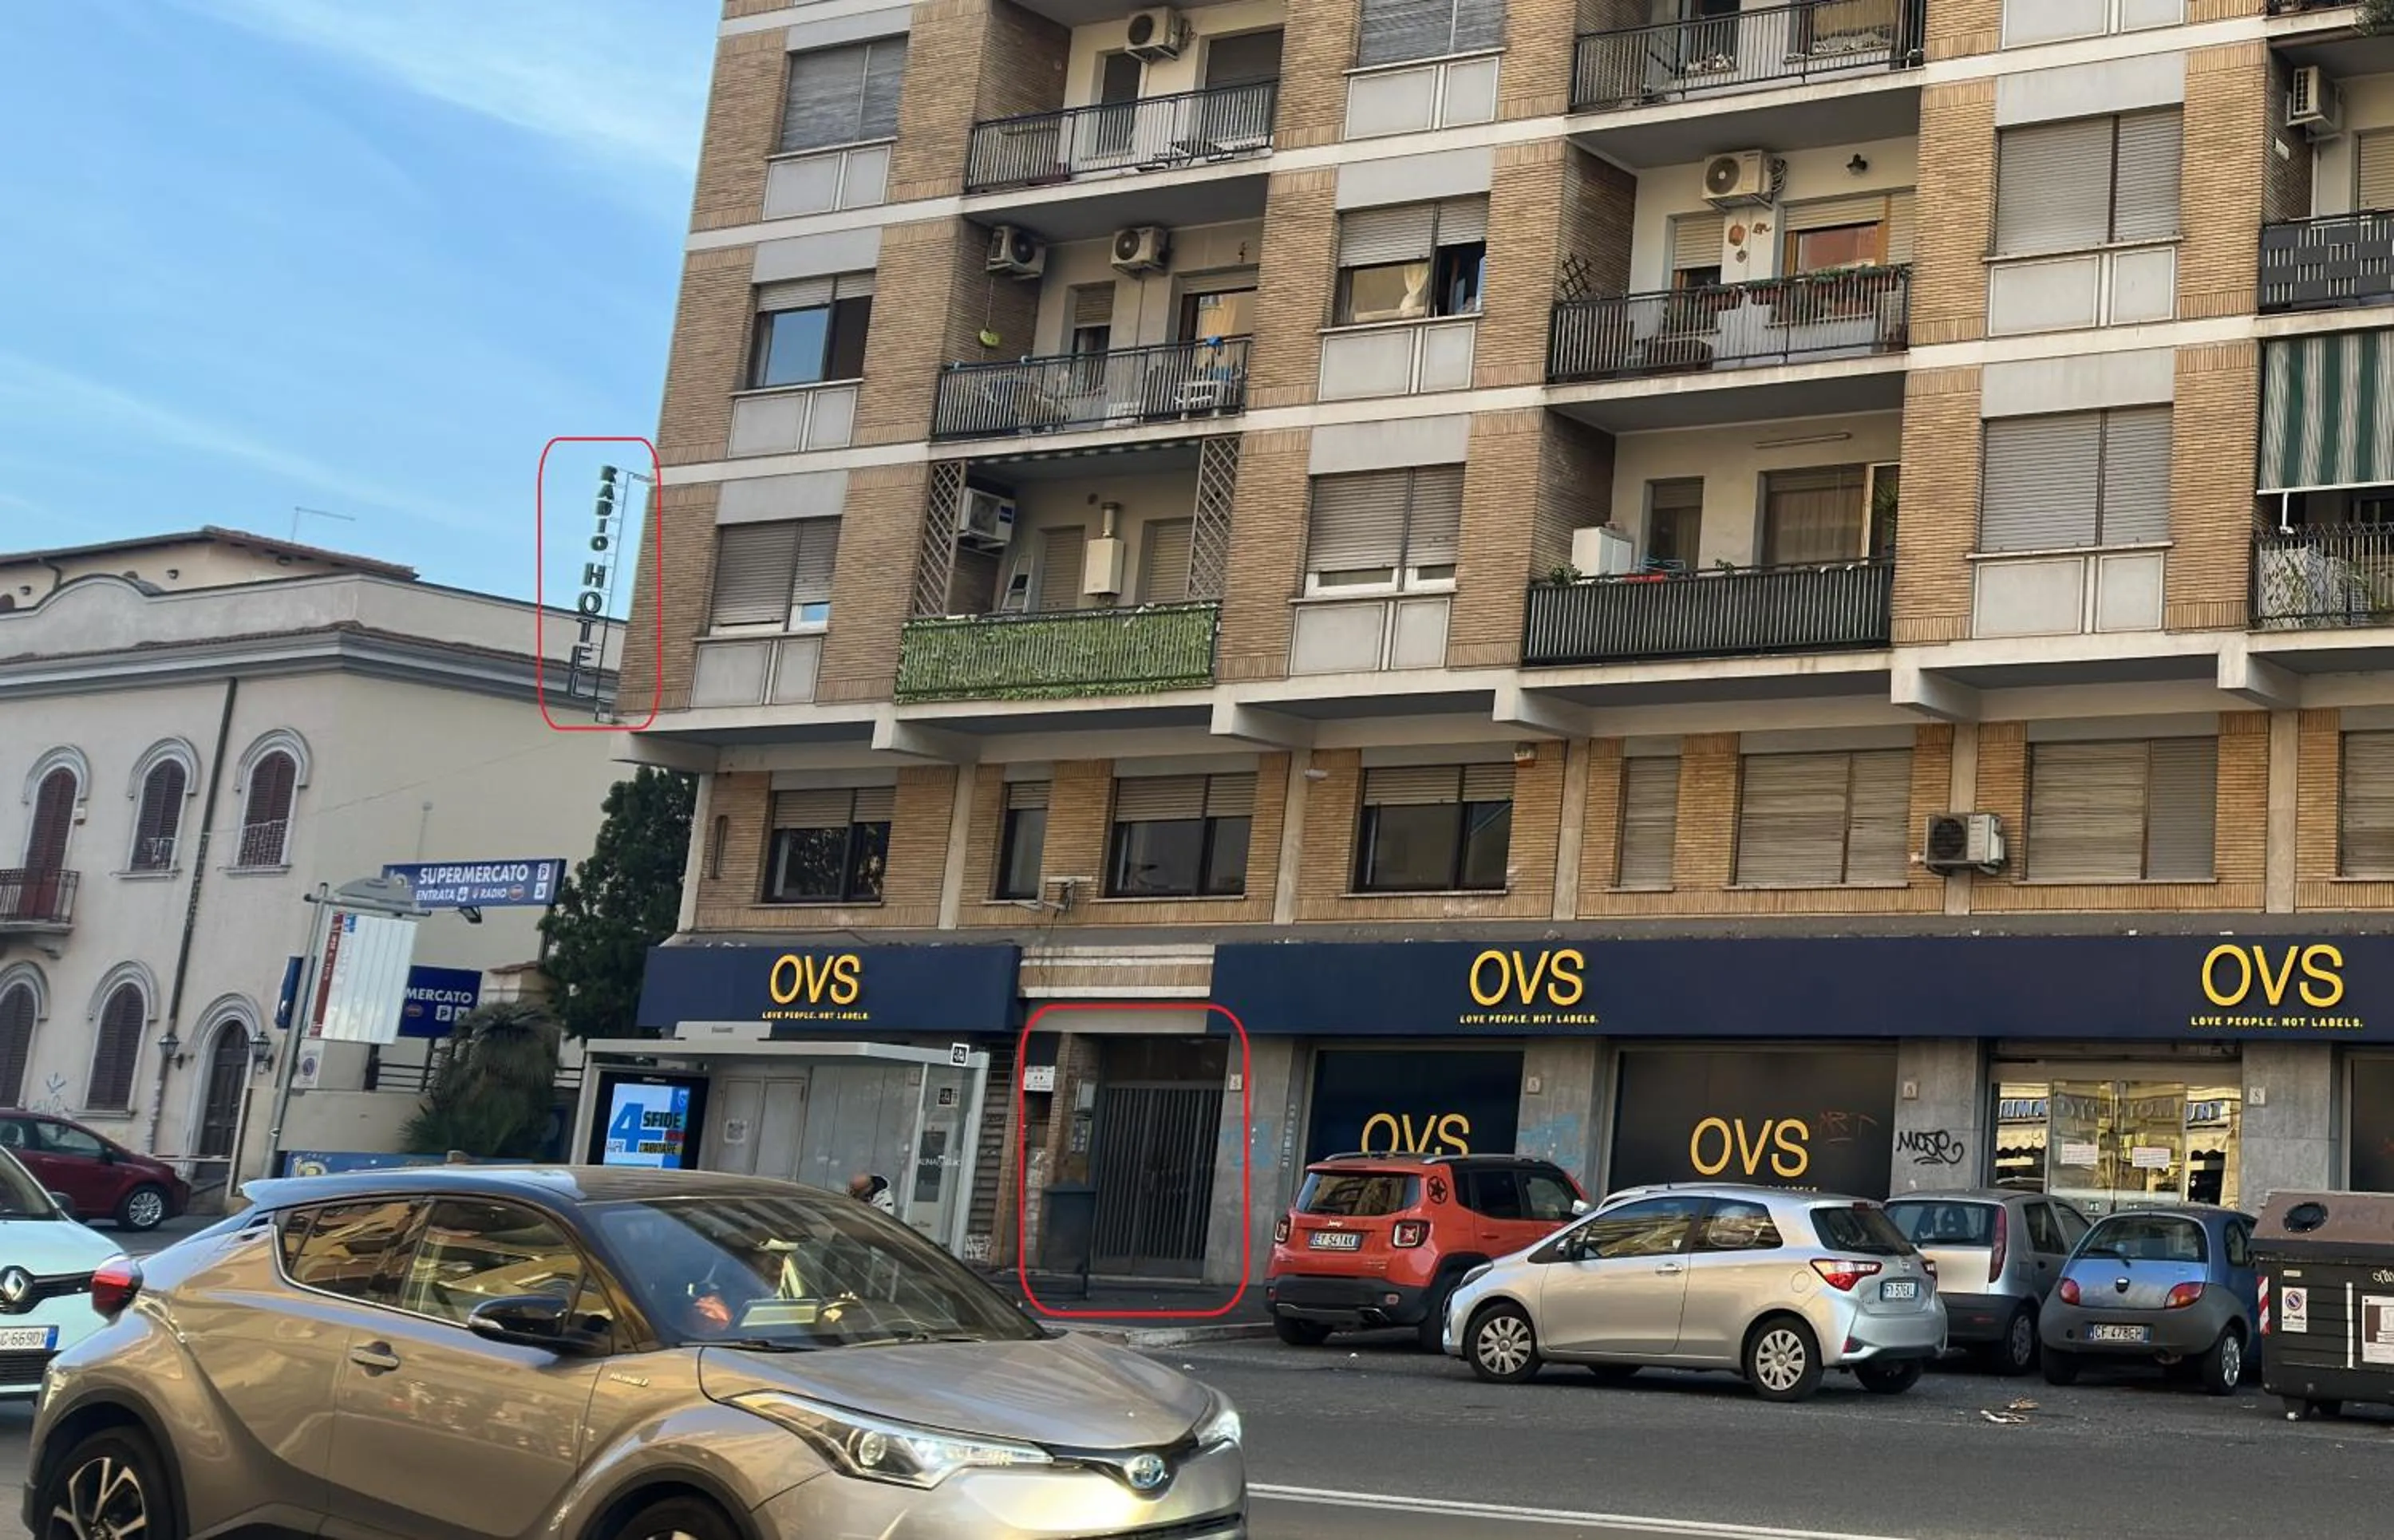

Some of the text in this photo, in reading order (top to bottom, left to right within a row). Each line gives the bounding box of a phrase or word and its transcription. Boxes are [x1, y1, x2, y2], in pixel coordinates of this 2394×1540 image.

[567, 465, 618, 698] RADIO HOTEL
[416, 888, 455, 901] ENTRATA
[418, 864, 529, 885] SUPERMERCATO
[406, 988, 472, 1004] MERCATO
[770, 954, 861, 1005] OVS
[1470, 949, 1584, 1005] OVS
[2202, 944, 2344, 1007] OVS
[1460, 1014, 1485, 1024] LOVE
[1533, 1014, 1552, 1024] NOT
[2191, 1017, 2364, 1027] LOVE PEOPLE. NOT LABELS.
[609, 1103, 662, 1152] 4
[642, 1111, 683, 1128] SFIDE
[1361, 1113, 1469, 1158] OVS
[1690, 1117, 1809, 1178] OVS
